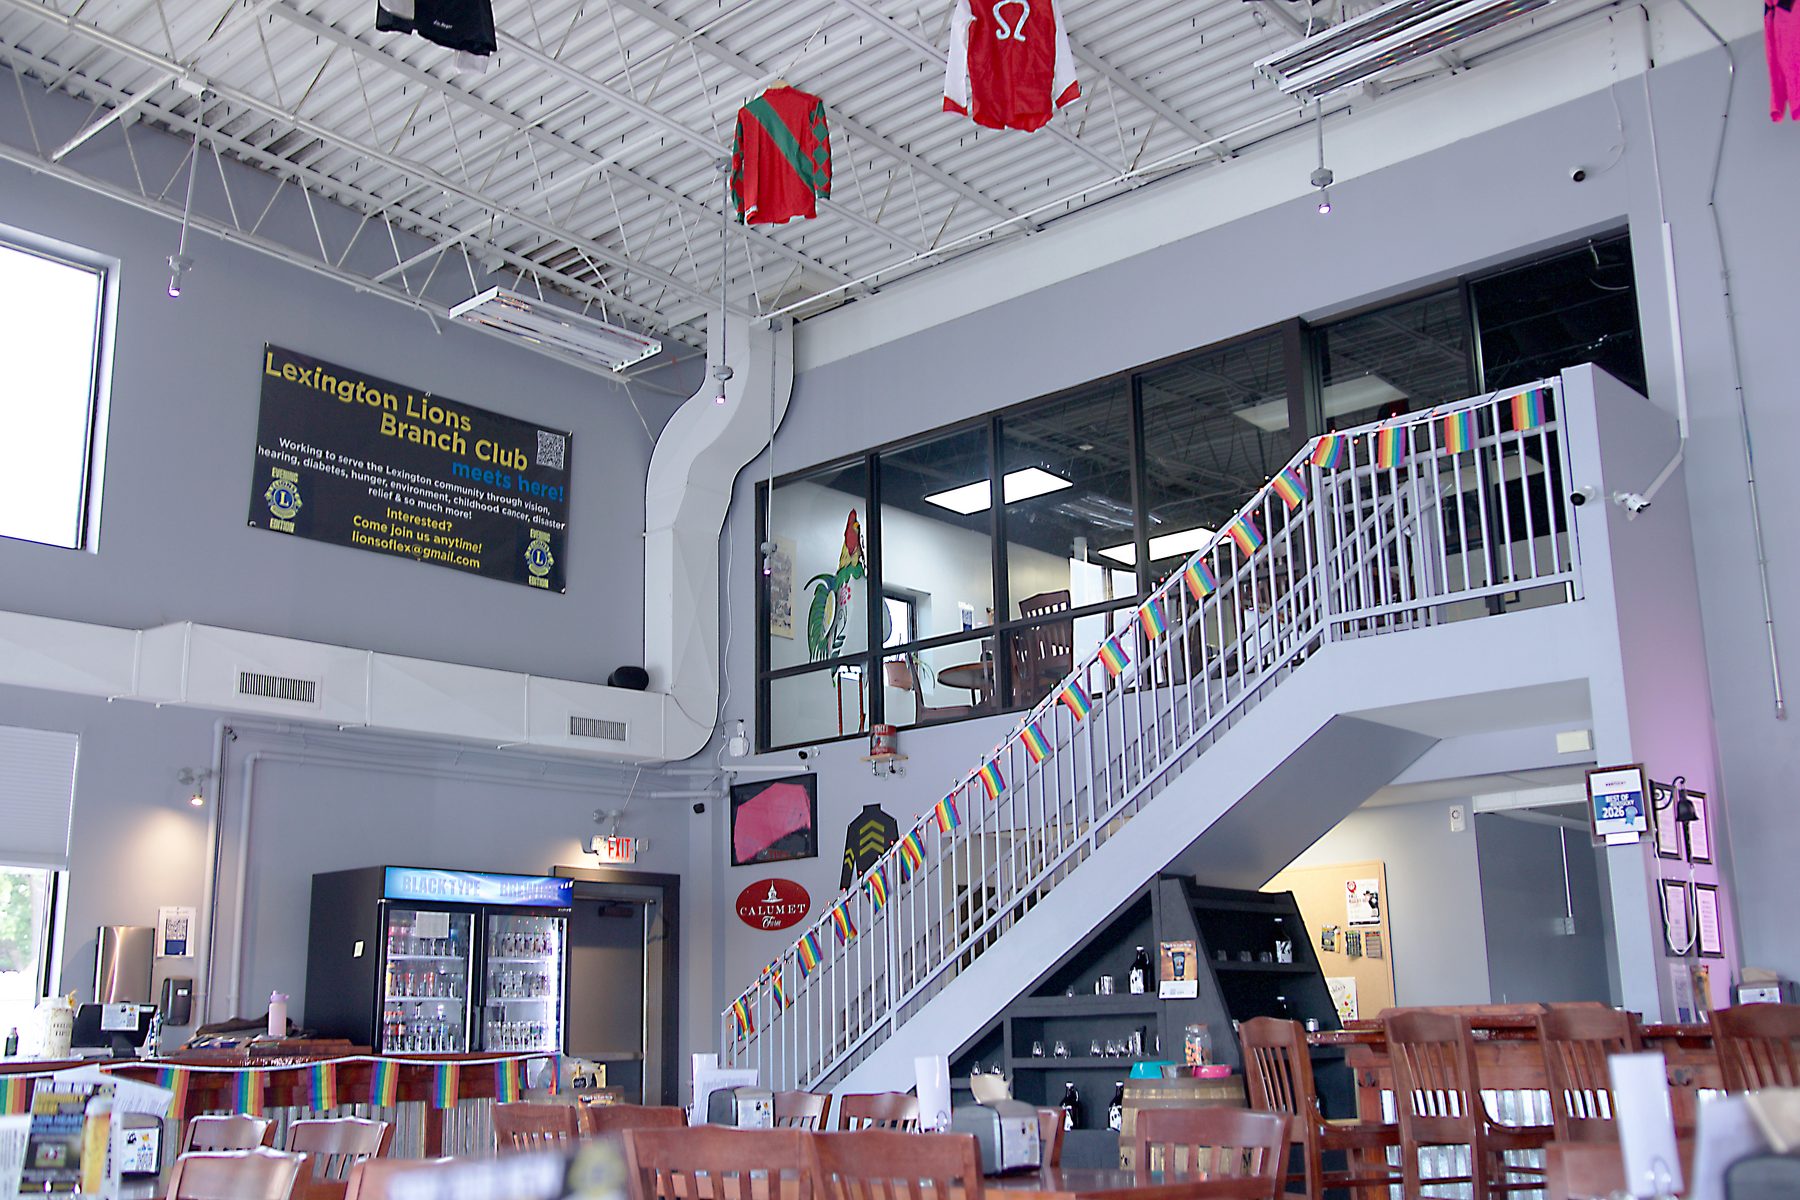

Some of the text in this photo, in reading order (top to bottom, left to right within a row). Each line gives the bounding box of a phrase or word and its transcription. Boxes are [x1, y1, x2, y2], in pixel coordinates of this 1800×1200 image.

[265, 351, 472, 432] Lexington Lions
[380, 411, 528, 471] Branch Club
[258, 445, 566, 530] hearing, diabetes, hunger, environment, childhood cancer, disaster
[279, 437, 551, 515] Working to serve the Lexington community through vision,
[451, 461, 564, 502] meets here!
[279, 490, 290, 507] L
[368, 487, 473, 520] relief & so much more!
[353, 515, 483, 554] Come join us anytime!
[386, 506, 453, 532] Interested?
[351, 530, 480, 569] lionsoflex@gmail.com
[1602, 806, 1626, 818] 2026
[608, 837, 631, 859] EXIT
[402, 875, 445, 896] BLACK
[740, 903, 806, 916] CALUMET
